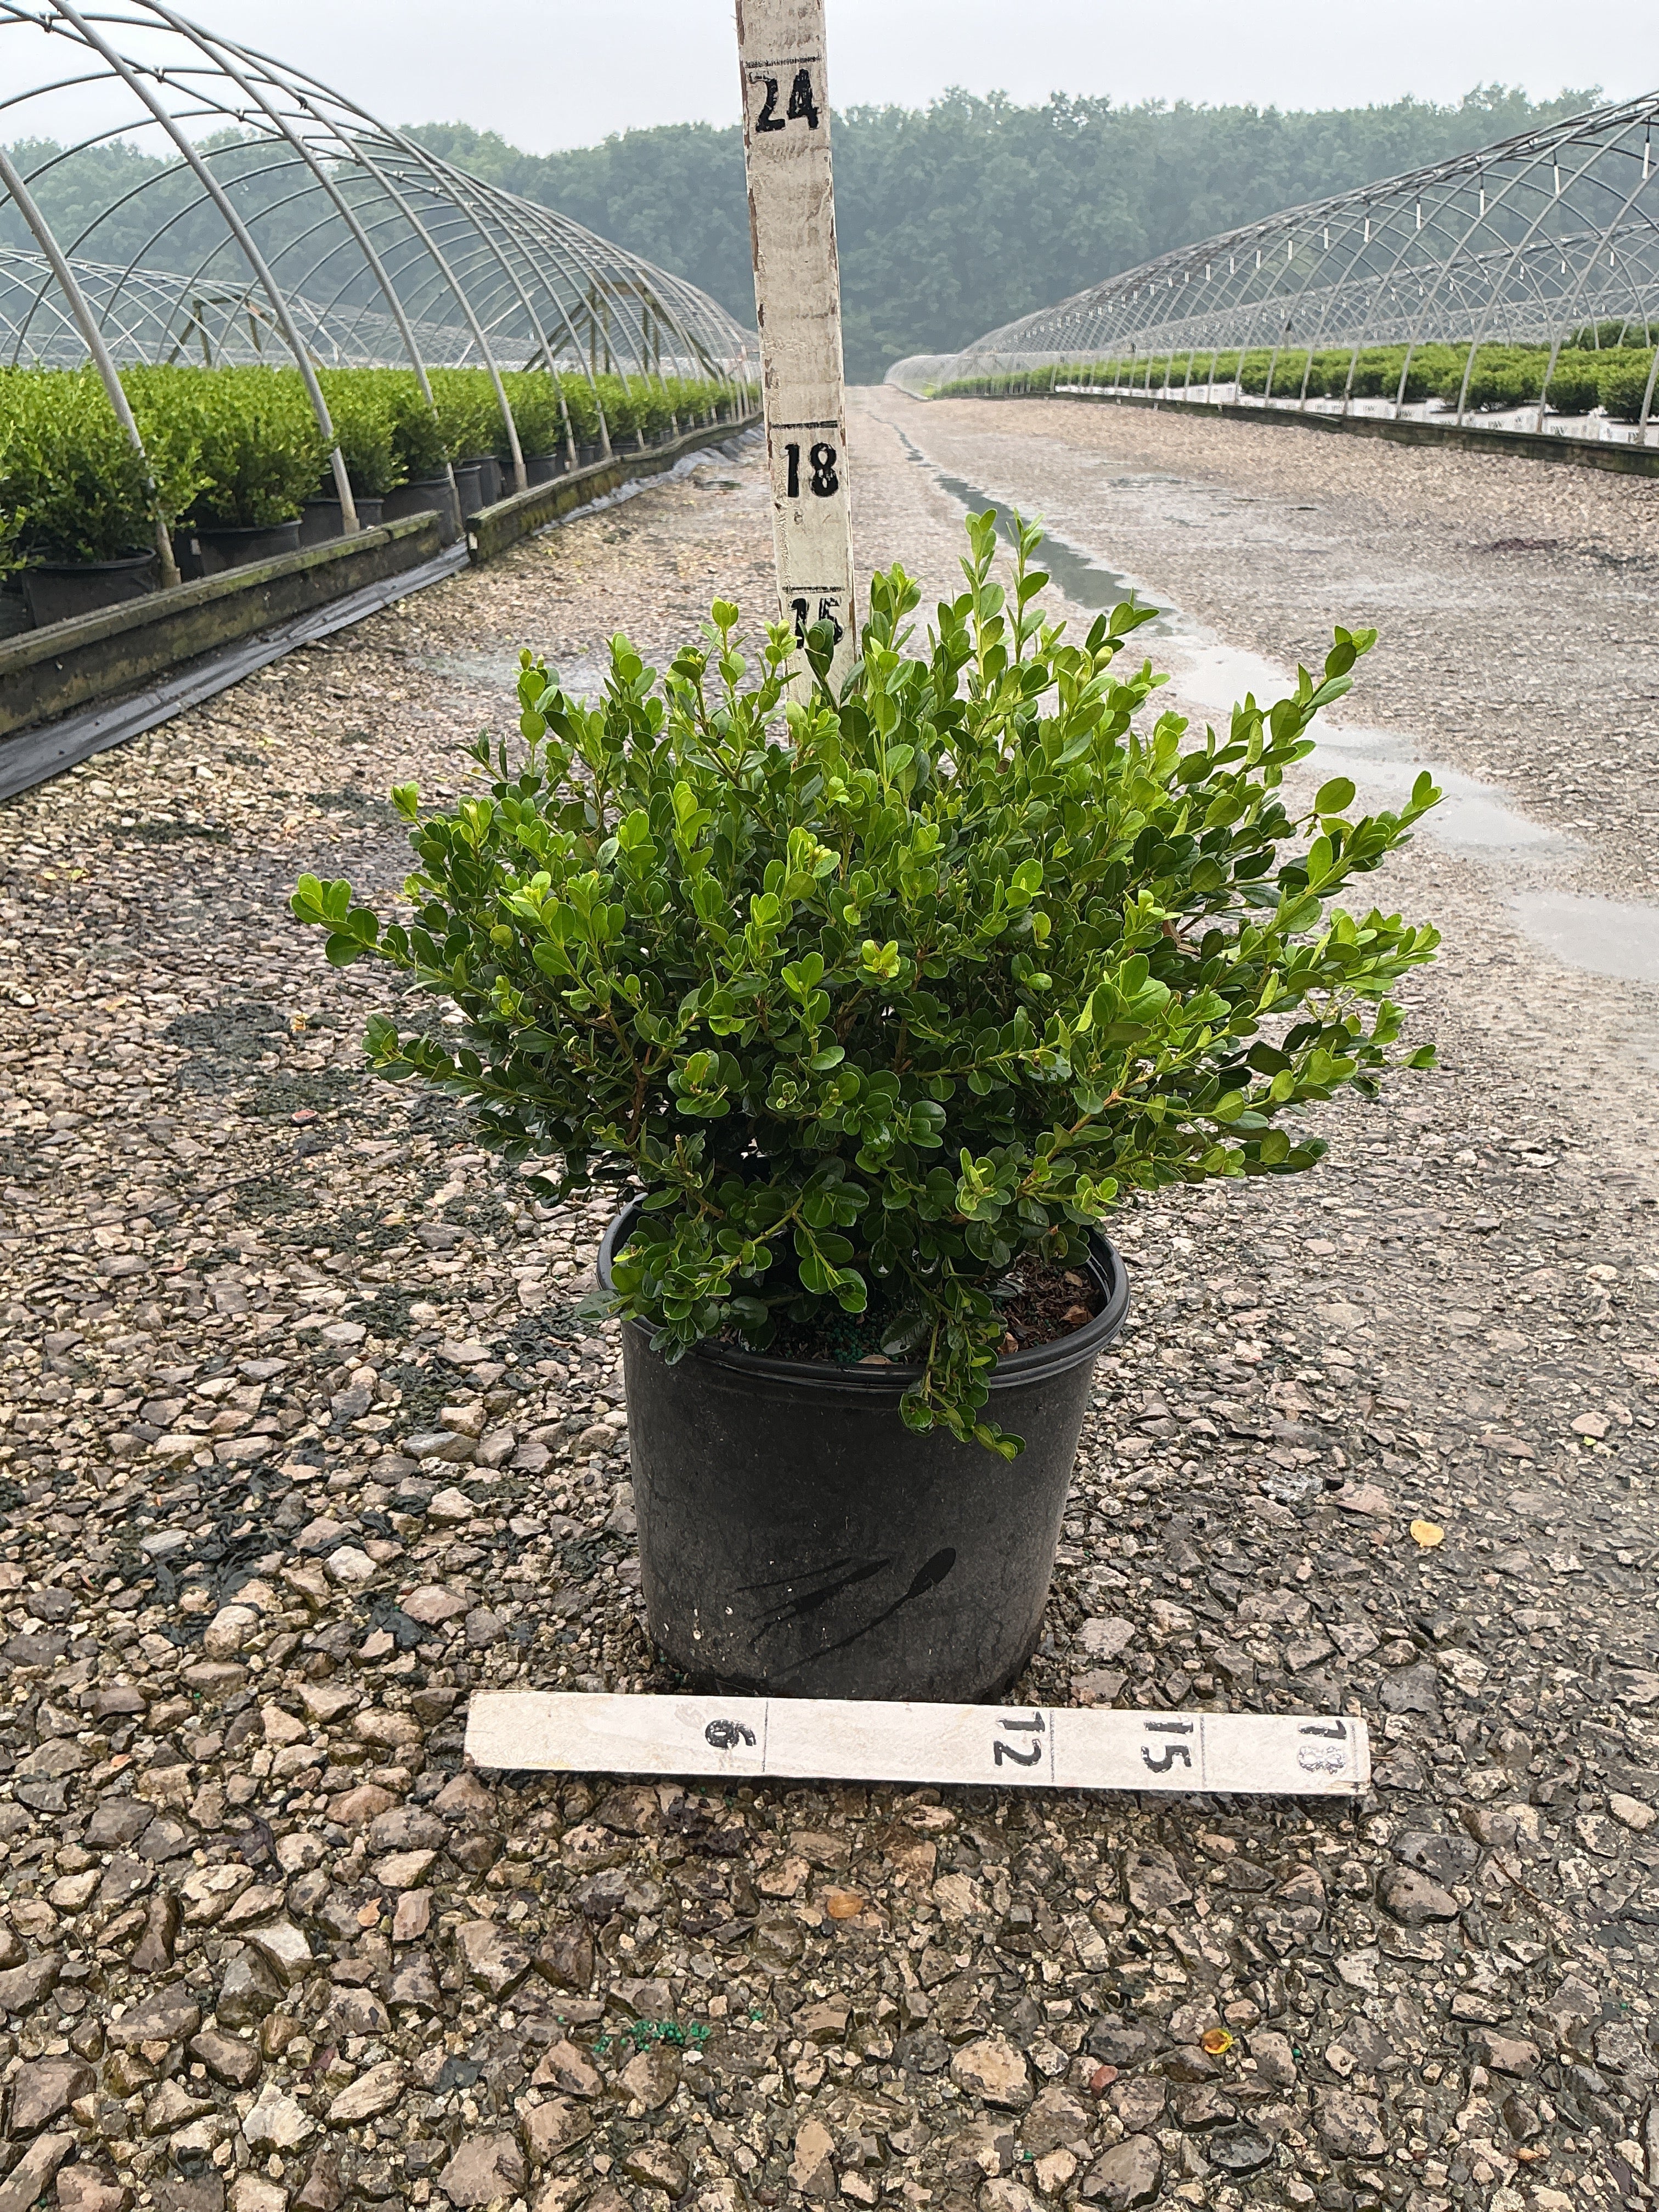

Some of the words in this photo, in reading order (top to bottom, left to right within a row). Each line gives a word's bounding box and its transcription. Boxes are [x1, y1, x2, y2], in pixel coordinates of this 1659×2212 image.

[749, 69, 819, 132] 24
[783, 443, 839, 497] 18
[791, 597, 844, 649] 15
[993, 1711, 1046, 1767] 12
[1141, 1719, 1194, 1773] 15
[1298, 1719, 1347, 1775] 18
